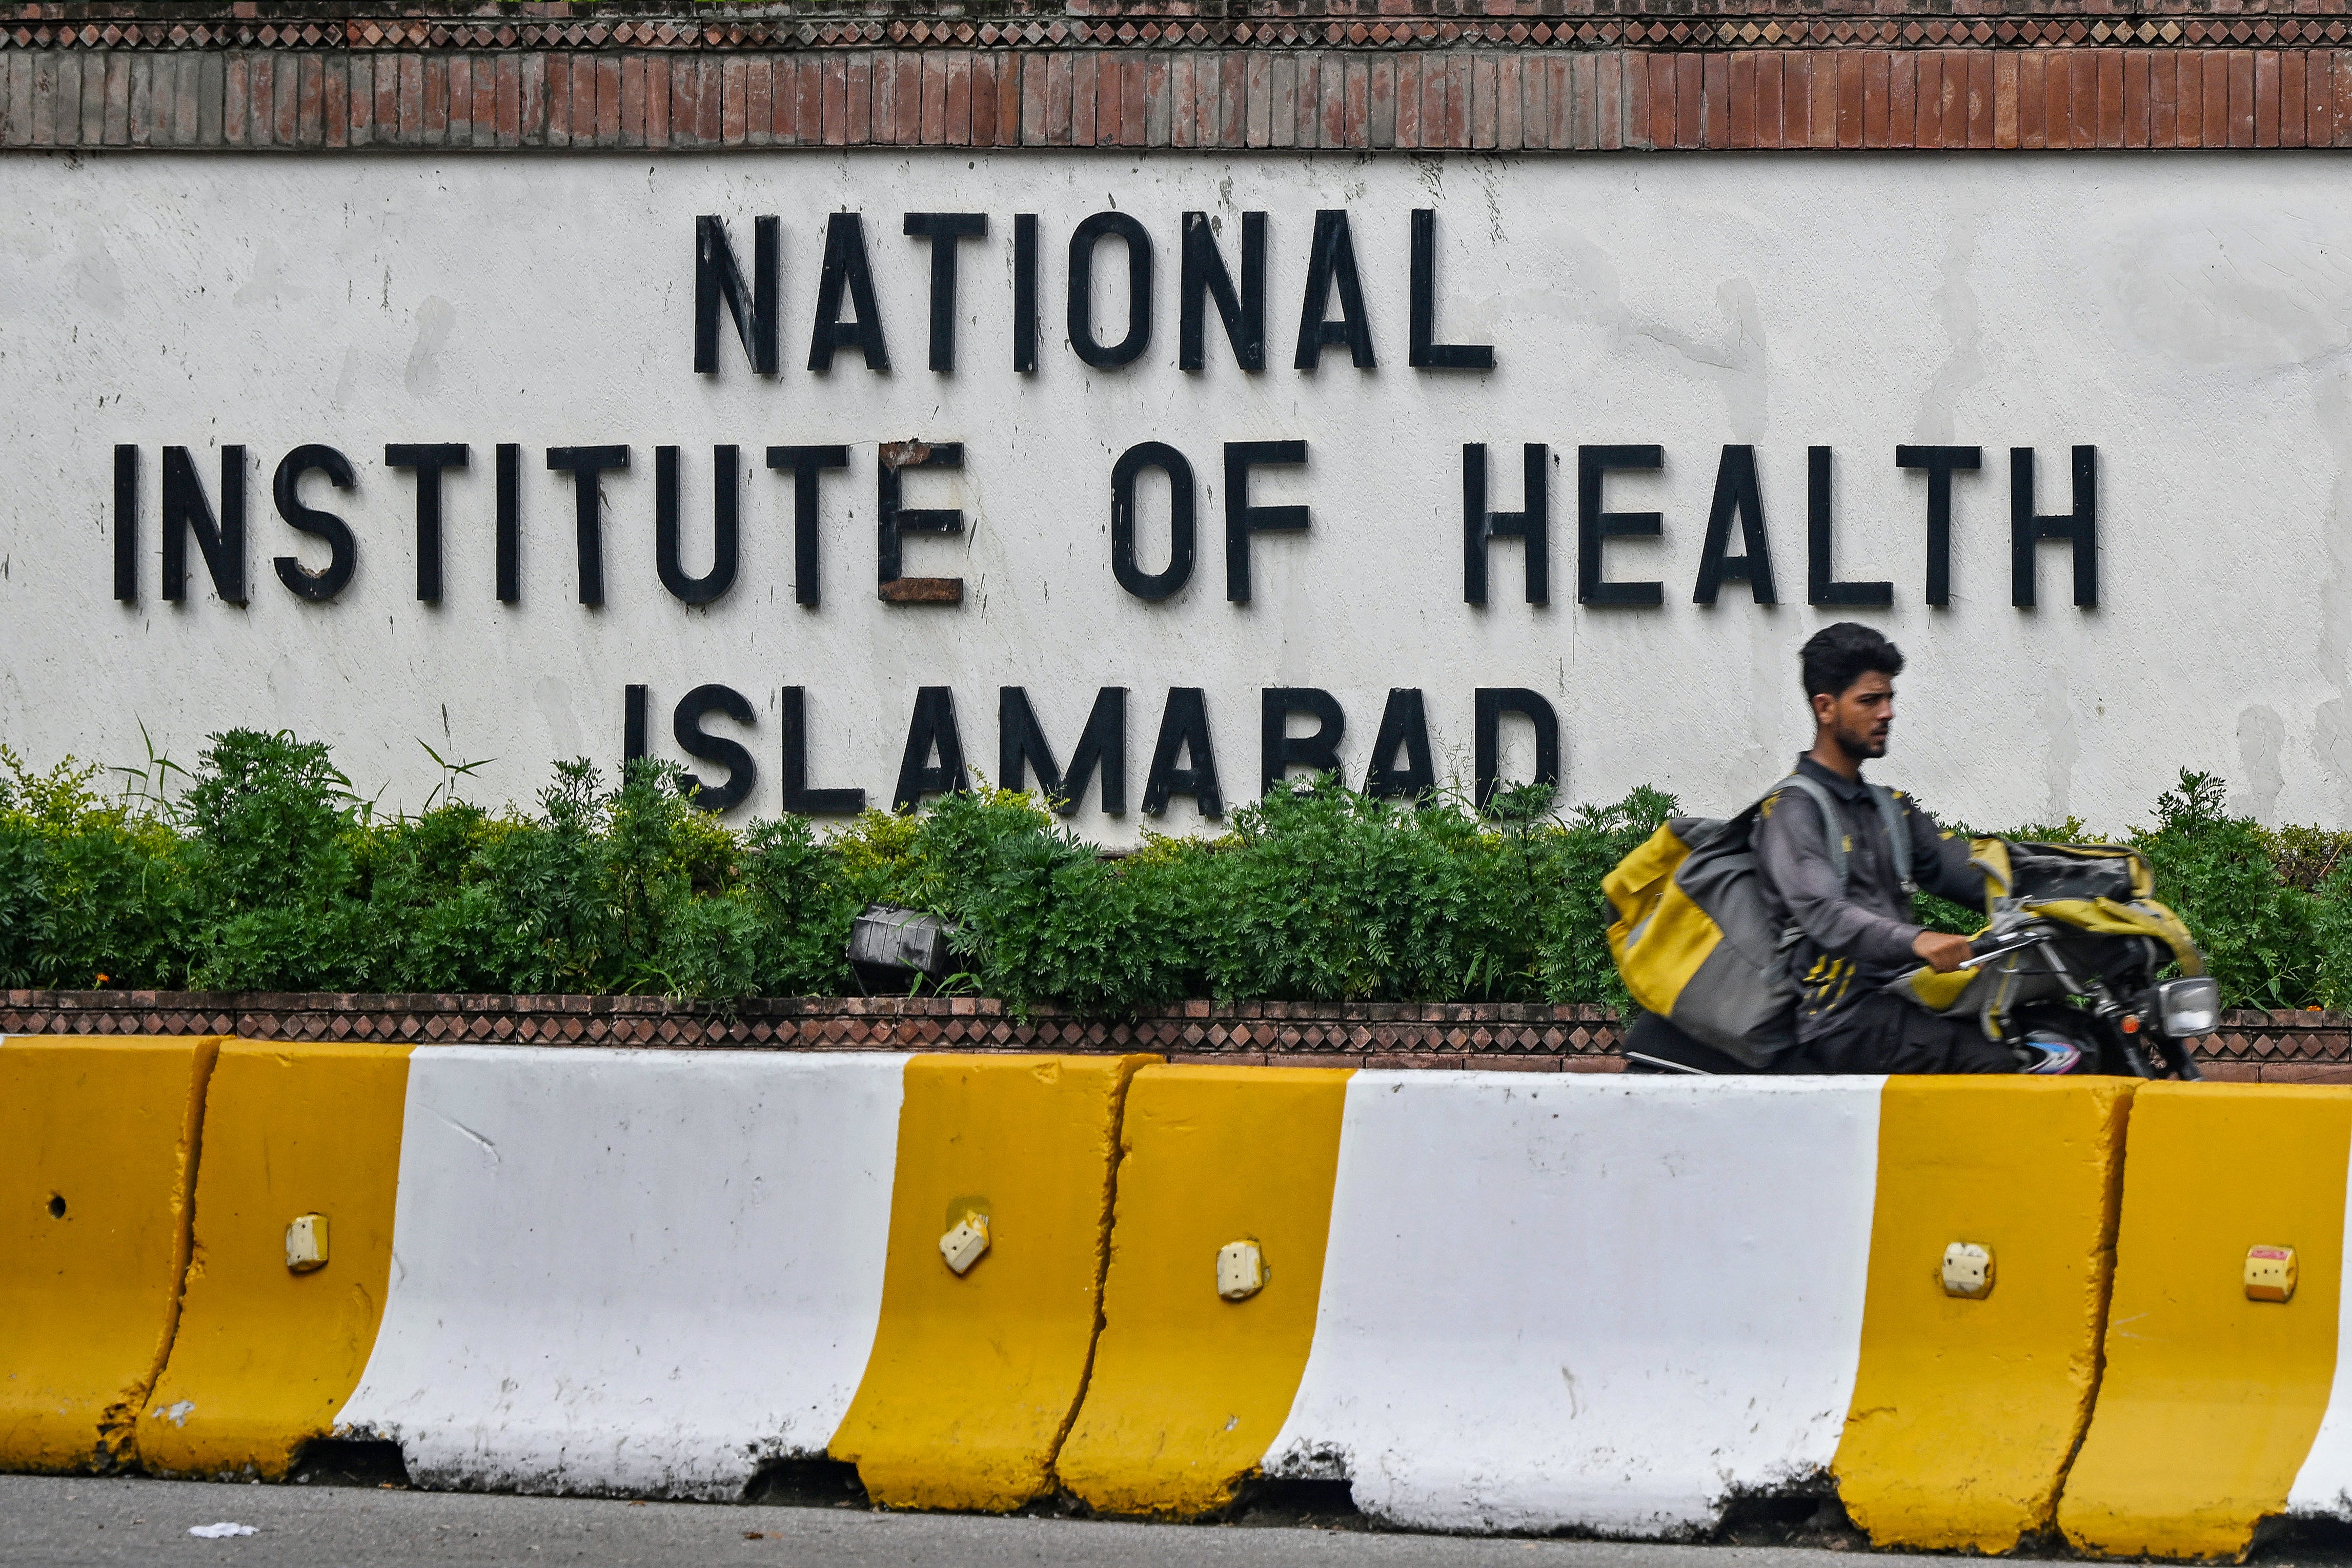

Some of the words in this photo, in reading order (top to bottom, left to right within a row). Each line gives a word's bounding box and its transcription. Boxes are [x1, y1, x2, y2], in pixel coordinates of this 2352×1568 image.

[694, 206, 1496, 379] NATIONAL
[114, 442, 966, 613] INSTITUTE
[1111, 440, 1311, 610] OF
[1463, 442, 2104, 616] HEALTH
[624, 683, 1562, 820] ISLAMABAD
